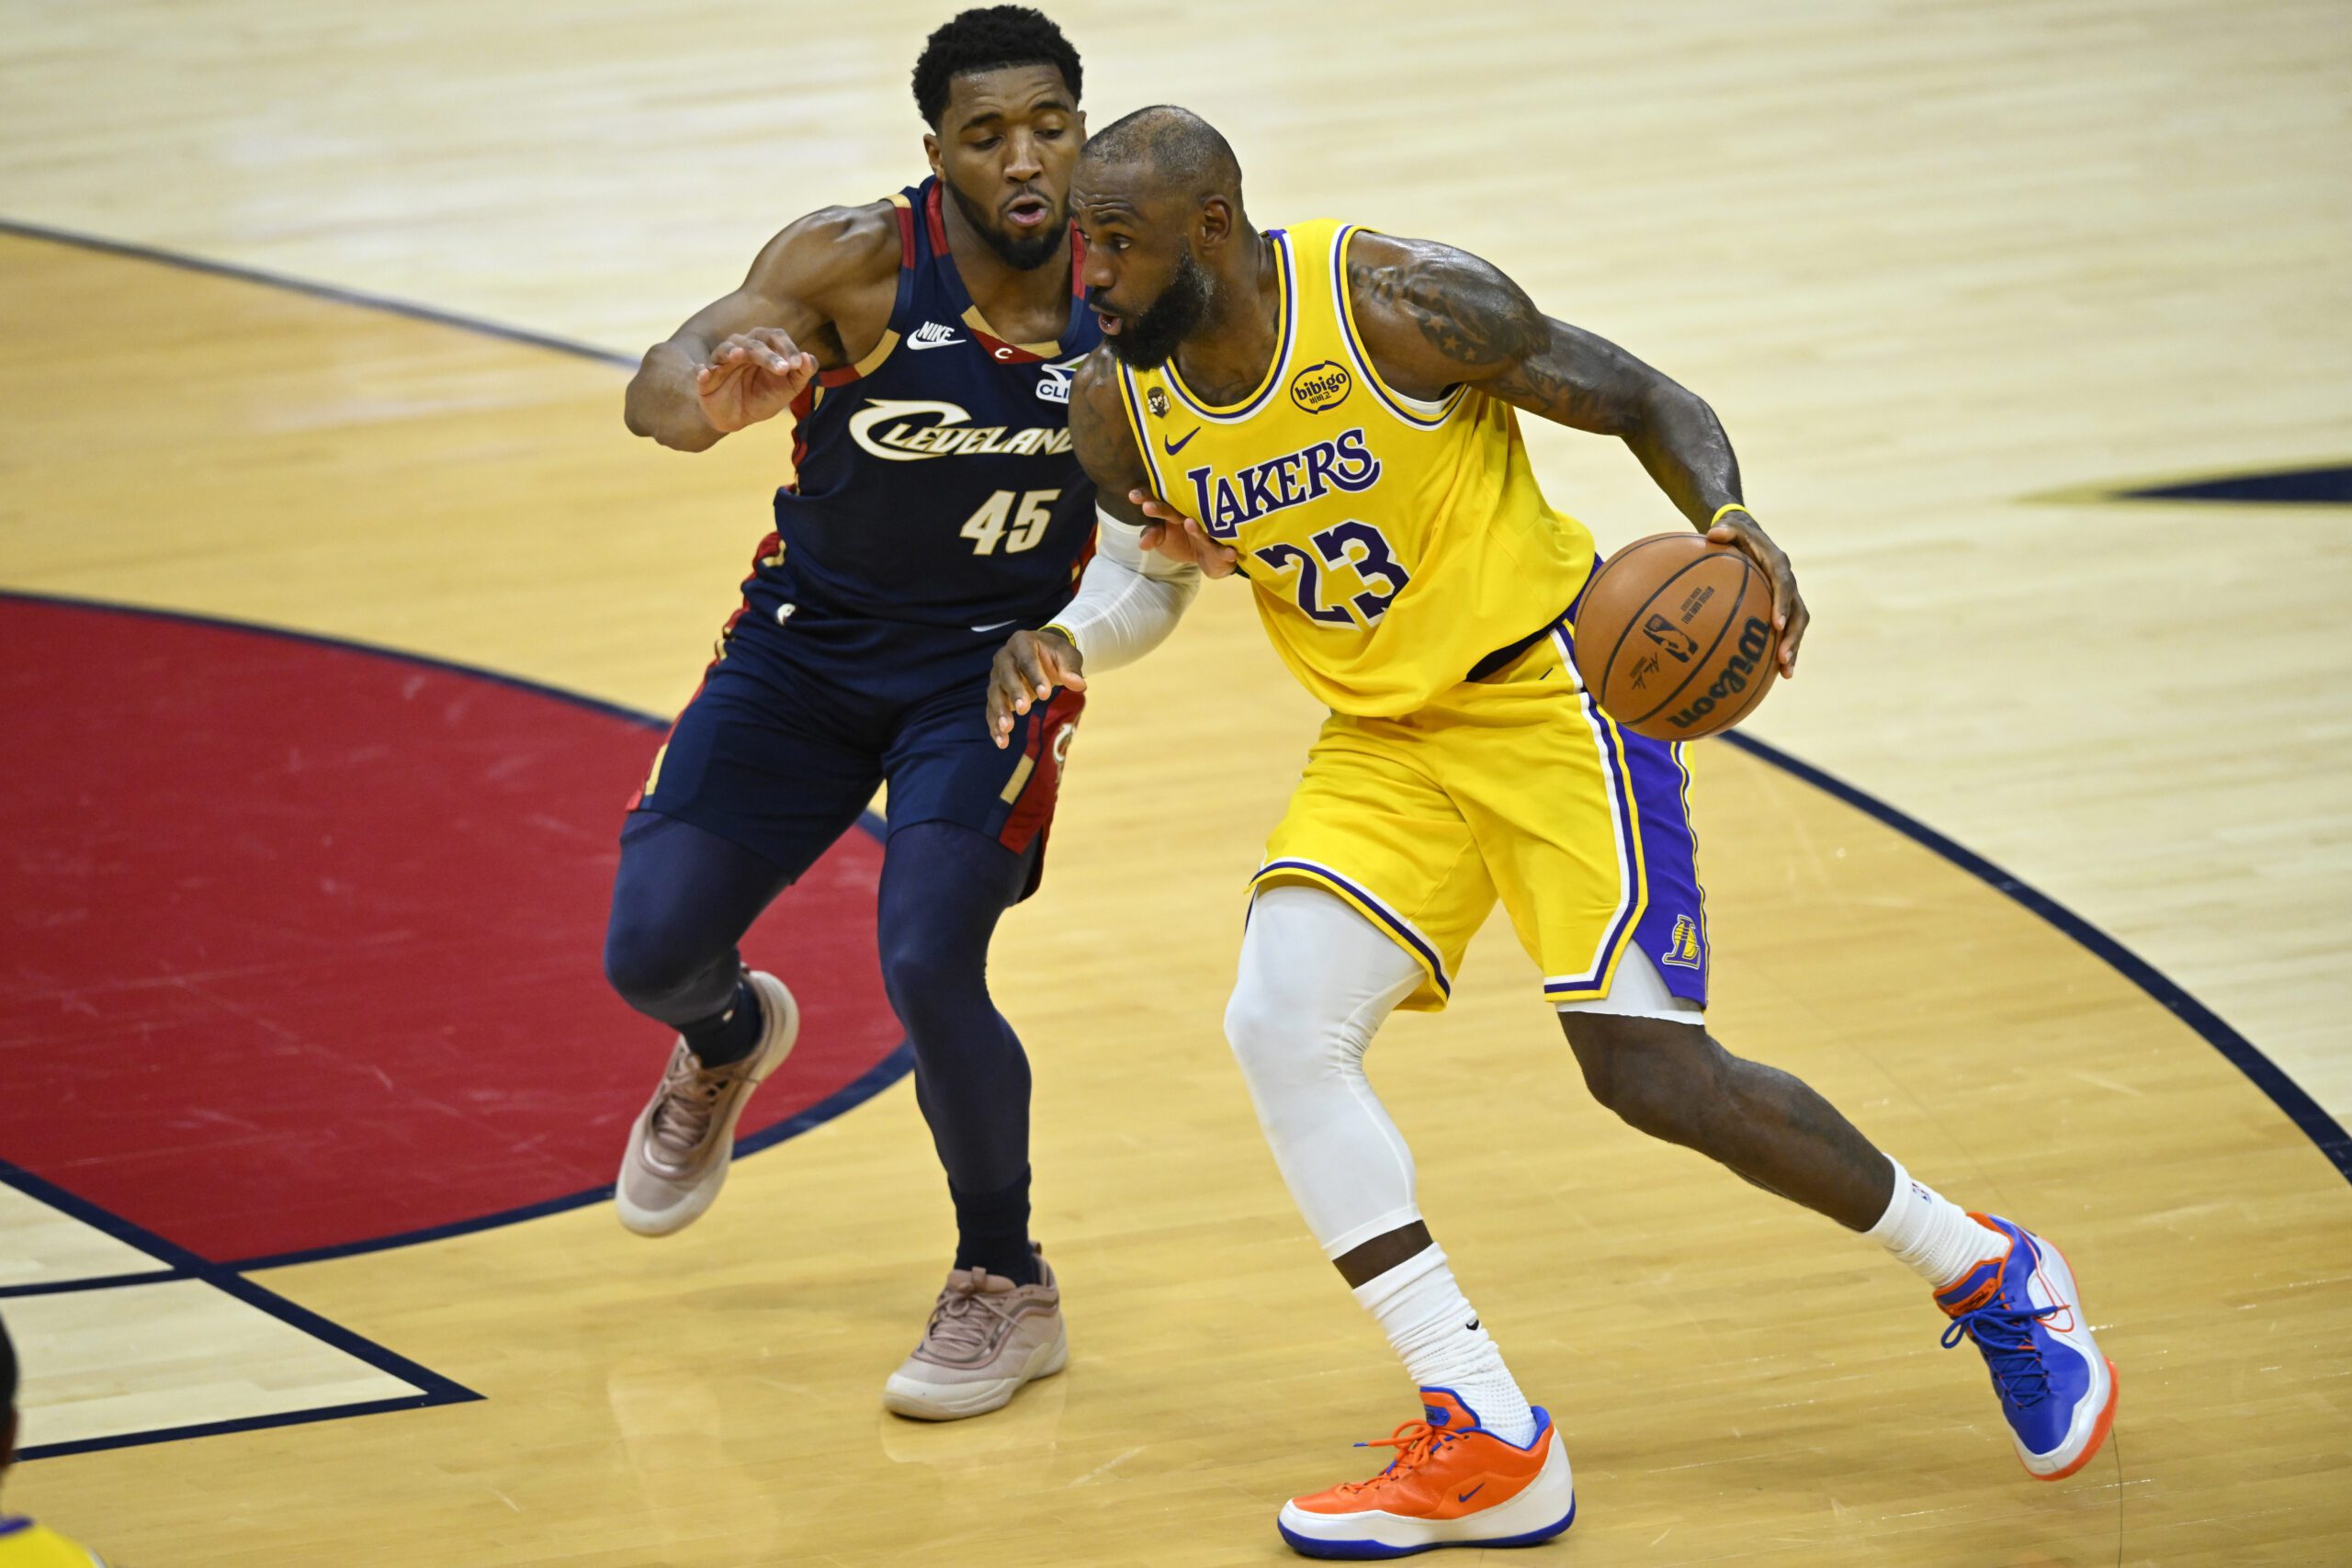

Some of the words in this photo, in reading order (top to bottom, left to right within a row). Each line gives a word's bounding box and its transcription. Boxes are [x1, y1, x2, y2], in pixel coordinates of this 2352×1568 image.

[917, 321, 956, 342] NIKE
[1295, 373, 1347, 400] bibigo
[960, 489, 1062, 556] 45
[1187, 427, 1381, 538] LAKERS
[1251, 519, 1410, 631] 23
[1666, 616, 1771, 728] Wilson
